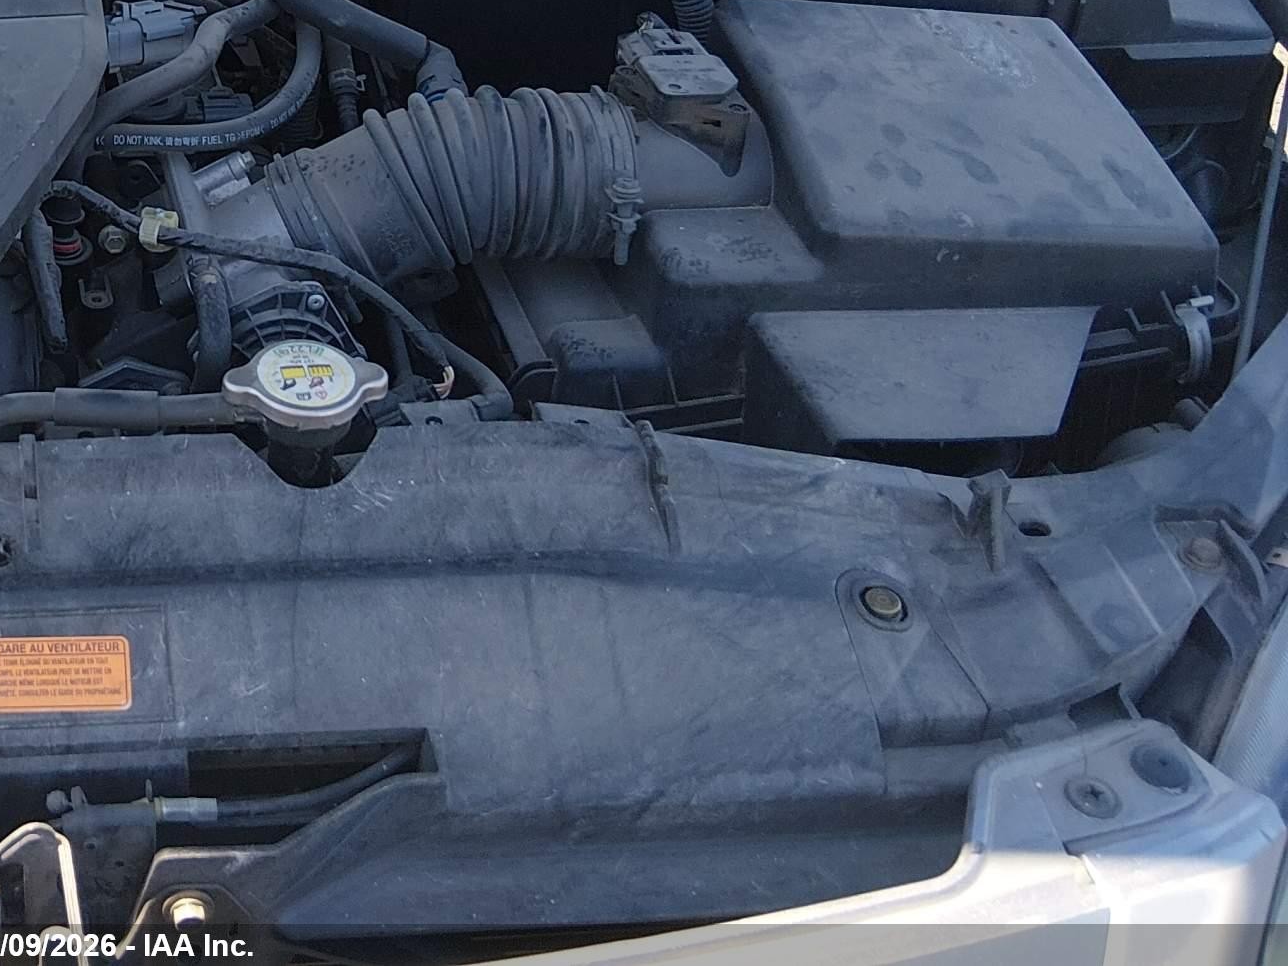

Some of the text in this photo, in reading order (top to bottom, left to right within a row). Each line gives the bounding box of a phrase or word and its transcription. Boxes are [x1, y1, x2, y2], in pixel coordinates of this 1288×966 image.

[114, 134, 125, 145] DO
[126, 134, 142, 145] NOT
[202, 135, 223, 146] FUEL
[30, 642, 45, 654] AU
[48, 641, 120, 653] VENTILATEUR
